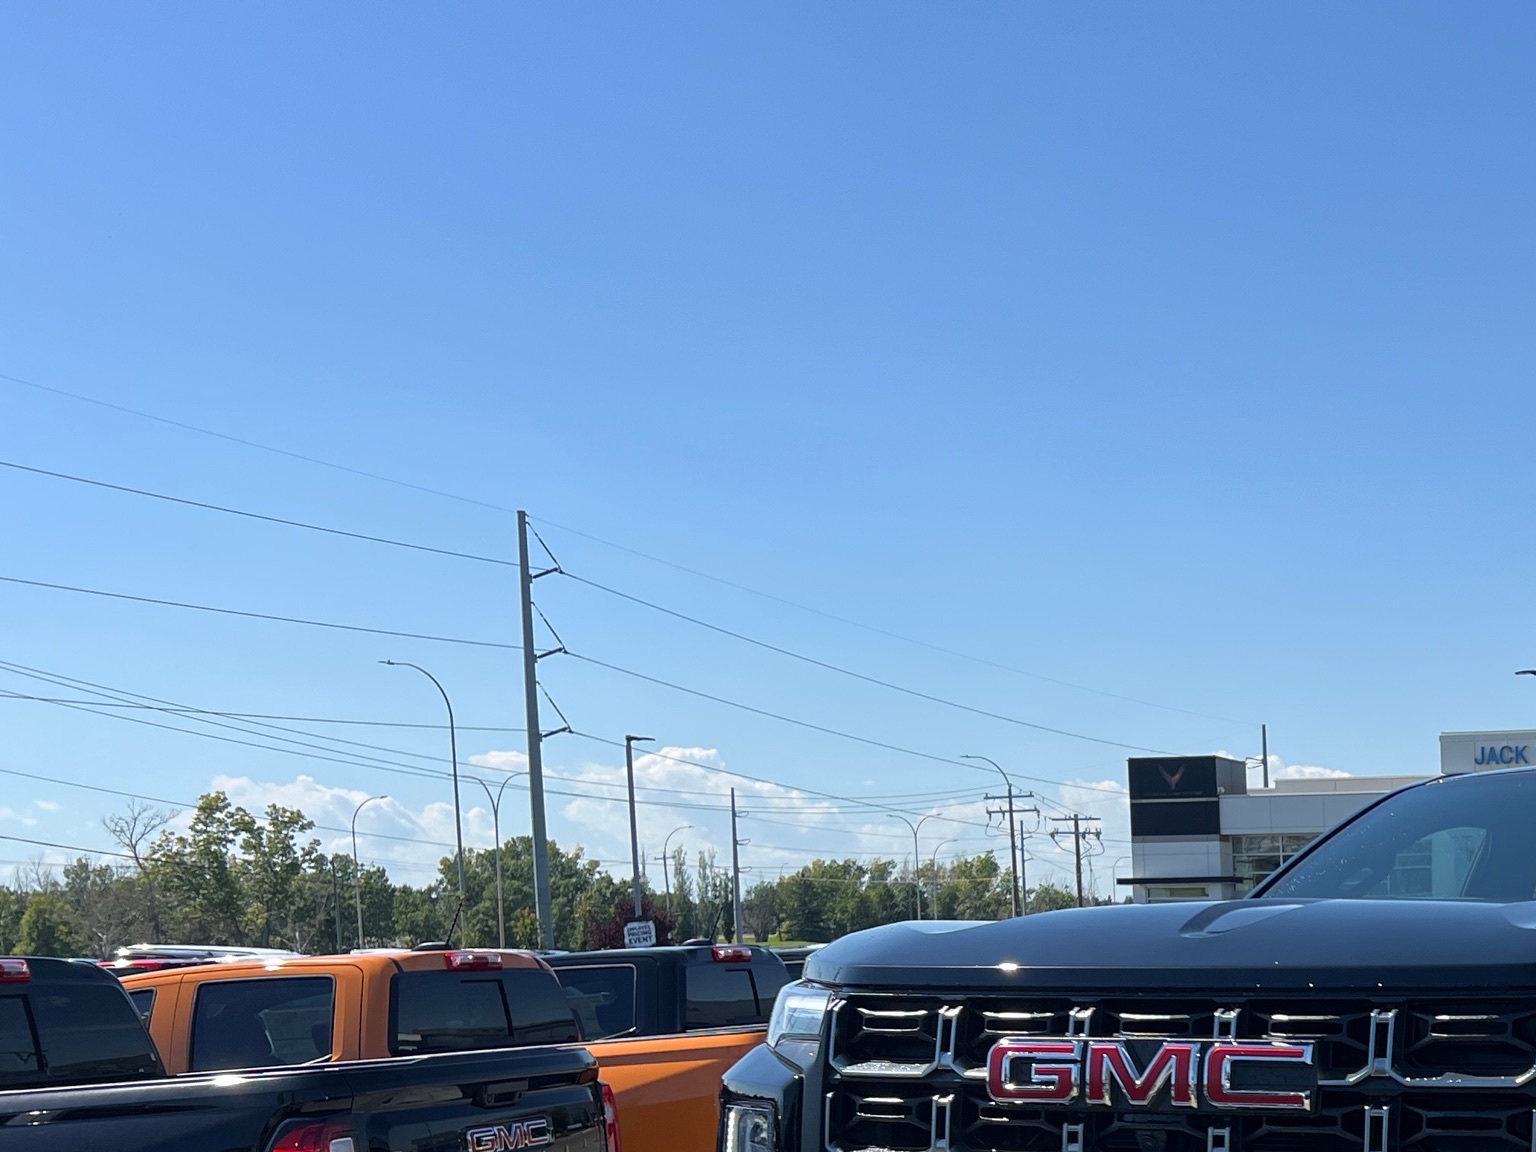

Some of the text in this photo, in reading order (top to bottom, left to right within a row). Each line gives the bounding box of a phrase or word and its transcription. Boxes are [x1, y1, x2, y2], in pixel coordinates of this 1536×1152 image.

[1474, 744, 1529, 766] JACK
[629, 935, 653, 945] EVENT
[986, 1036, 1316, 1111] GMC
